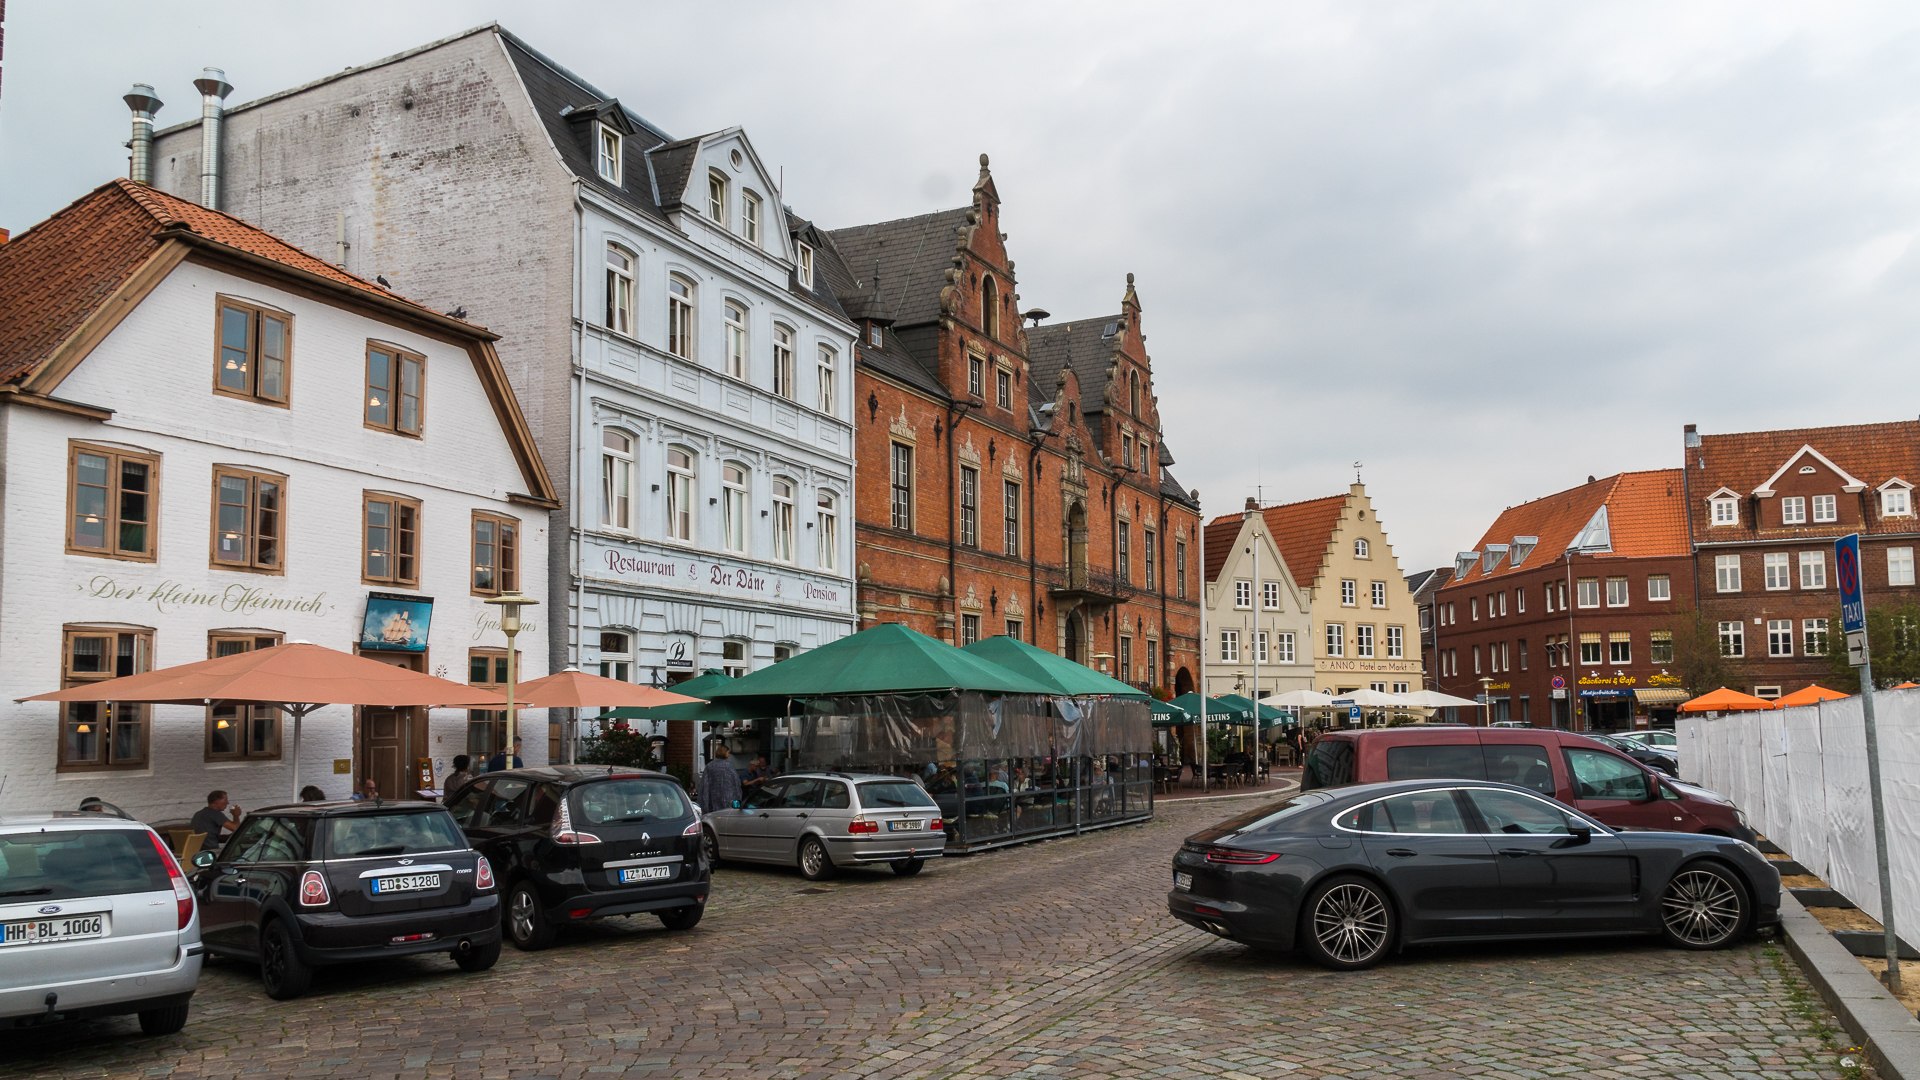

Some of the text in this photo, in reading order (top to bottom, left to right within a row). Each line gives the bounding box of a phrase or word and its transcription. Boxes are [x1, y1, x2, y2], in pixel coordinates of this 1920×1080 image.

[604, 549, 676, 577] Restaurant
[710, 564, 732, 586] Der
[89, 575, 327, 616] Der kleine Heinrich
[803, 582, 837, 602] Pension
[1843, 601, 1861, 624] TAXI
[472, 608, 537, 640] Gasus
[1330, 661, 1355, 670] ANNO
[1360, 662, 1376, 671] Hotel
[1389, 662, 1407, 671] Markt
[1206, 713, 1231, 721] ELTINS
[1351, 707, 1359, 717] P
[380, 875, 439, 891] ED S 1280
[625, 866, 668, 880] IZ AL 777
[5, 918, 100, 941] HH BL 1006
